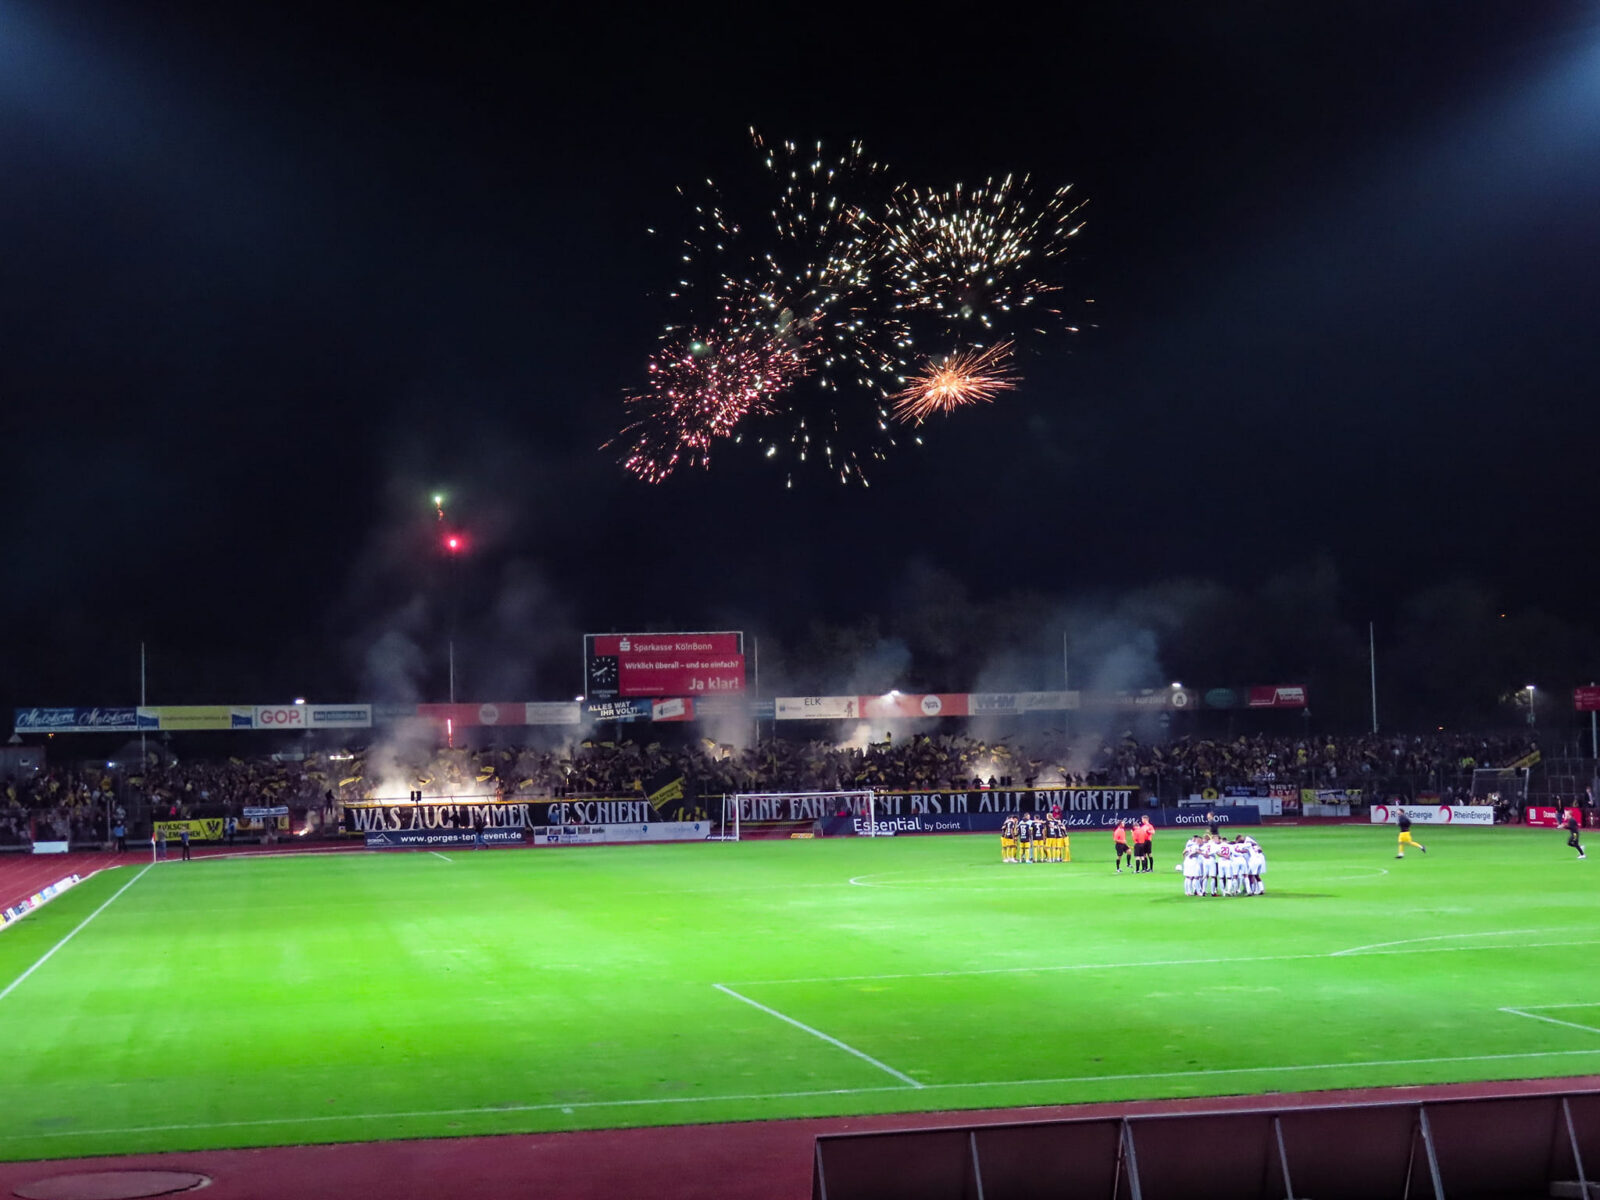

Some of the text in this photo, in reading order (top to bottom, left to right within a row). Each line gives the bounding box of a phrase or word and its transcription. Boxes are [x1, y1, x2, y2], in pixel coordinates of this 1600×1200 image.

[634, 642, 713, 653] Sparkasse KölnBonn
[625, 662, 654, 670] Wirklich
[655, 661, 679, 670] überall
[686, 661, 700, 669] und
[710, 661, 739, 669] einfach?
[688, 677, 739, 690] Ja klar!
[588, 701, 631, 712] ALLES WAT
[804, 697, 822, 706] ELK
[260, 709, 302, 724] GOP.
[600, 709, 614, 717] IHR
[911, 793, 943, 815] BIS
[950, 793, 969, 813] IN
[1034, 790, 1132, 811] EWIGKEIT
[351, 806, 401, 831] WAS
[466, 803, 536, 830] IMMER
[1060, 813, 1096, 826] okal.
[1175, 813, 1229, 824] dorint.om
[1390, 810, 1433, 820] RnEnergie
[1453, 810, 1491, 821] RheinEnergie
[853, 817, 960, 832] Essential by Dorint
